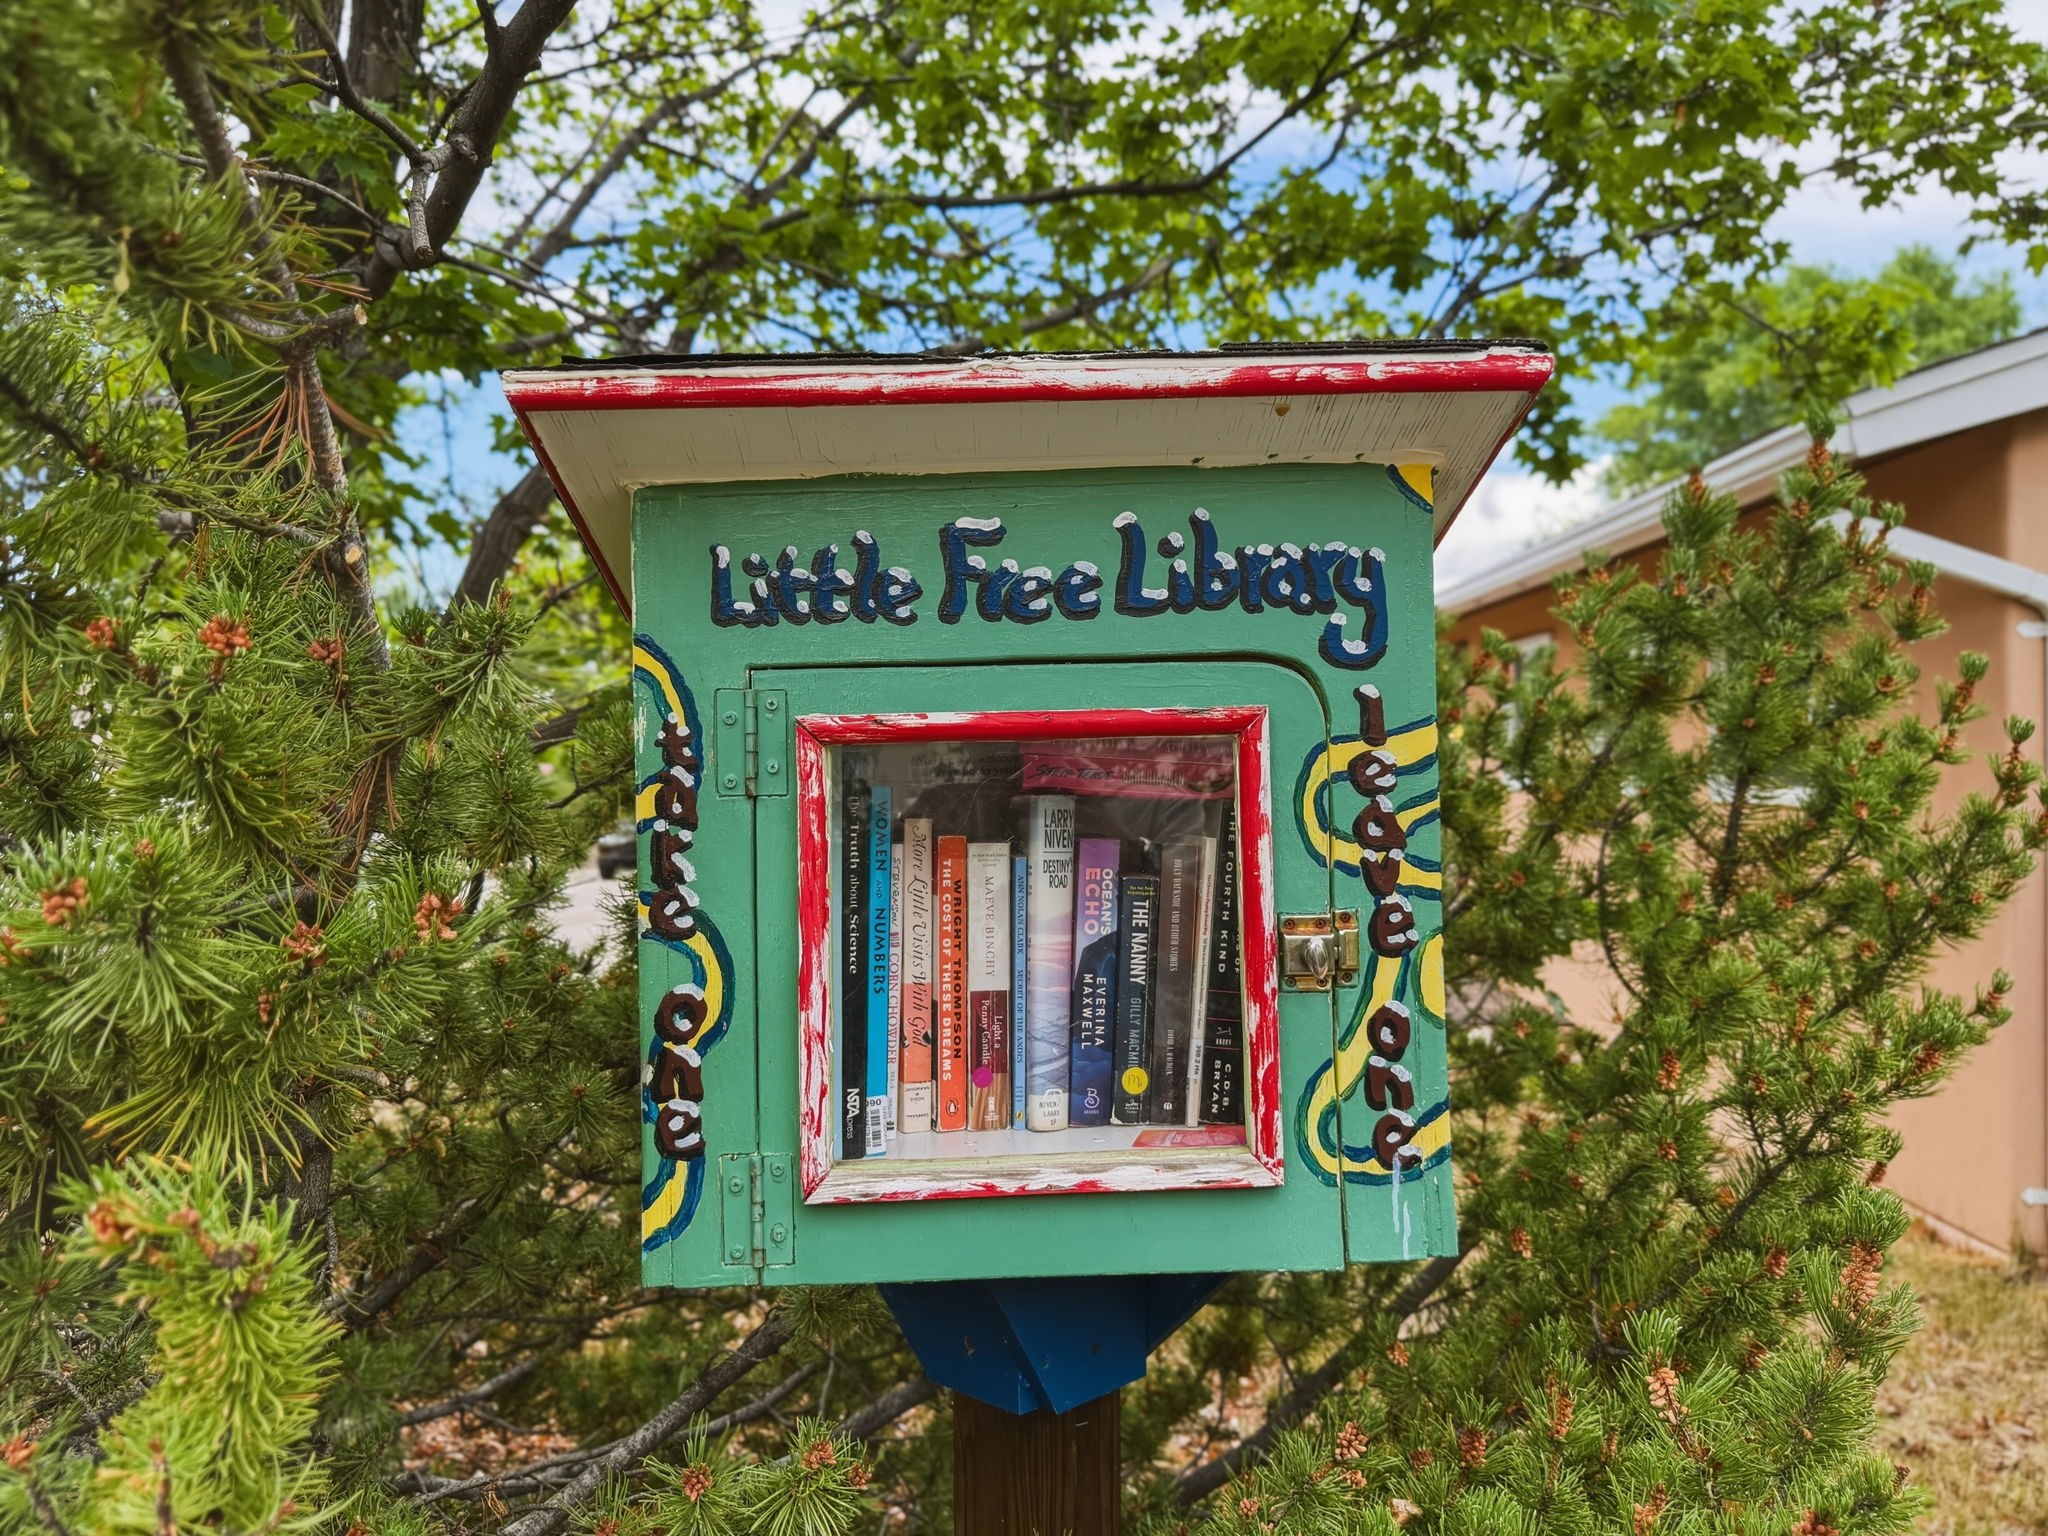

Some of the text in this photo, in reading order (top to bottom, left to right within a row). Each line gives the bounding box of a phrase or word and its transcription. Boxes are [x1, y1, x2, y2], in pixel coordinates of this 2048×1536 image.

[709, 507, 1389, 671] Little Free Library
[850, 821, 860, 869] Truth
[875, 801, 889, 872] WOMEN
[1044, 809, 1074, 828] LARRY
[1044, 829, 1074, 849] NIVEN
[850, 873, 860, 908] about
[1048, 875, 1069, 889] ROAD
[1084, 867, 1101, 936] ECHO
[1100, 868, 1114, 936] OCEAN'S
[1132, 900, 1149, 927] THE
[1218, 810, 1237, 973] THE FOURTH KIND
[650, 712, 707, 1161] take one
[849, 914, 860, 974] Science
[873, 907, 887, 995] NUMBERS
[907, 825, 929, 1048] More Little Visits With God
[984, 876, 995, 977] MAEVE BINCHY
[1129, 932, 1148, 986] NANNY
[1347, 683, 1424, 1171] leave one
[888, 952, 900, 993] CORN
[942, 858, 952, 1081] THE COST OF THESE DREAMS
[953, 879, 962, 1059] WRIGHT THOMPSON
[1015, 875, 1024, 1064] ANN NOLAN CLARK SECRET OF THE ANDES
[887, 995, 899, 1065] CHOWDER
[980, 1000, 991, 1065] Penny Candle
[992, 1015, 1003, 1038] Light
[1081, 973, 1093, 1050] MAXWELL
[1094, 977, 1107, 1047] EVERINA
[1129, 997, 1142, 1026] GILLY
[1211, 1060, 1222, 1113] BRYAN
[1222, 1063, 1232, 1111] C.D.B.
